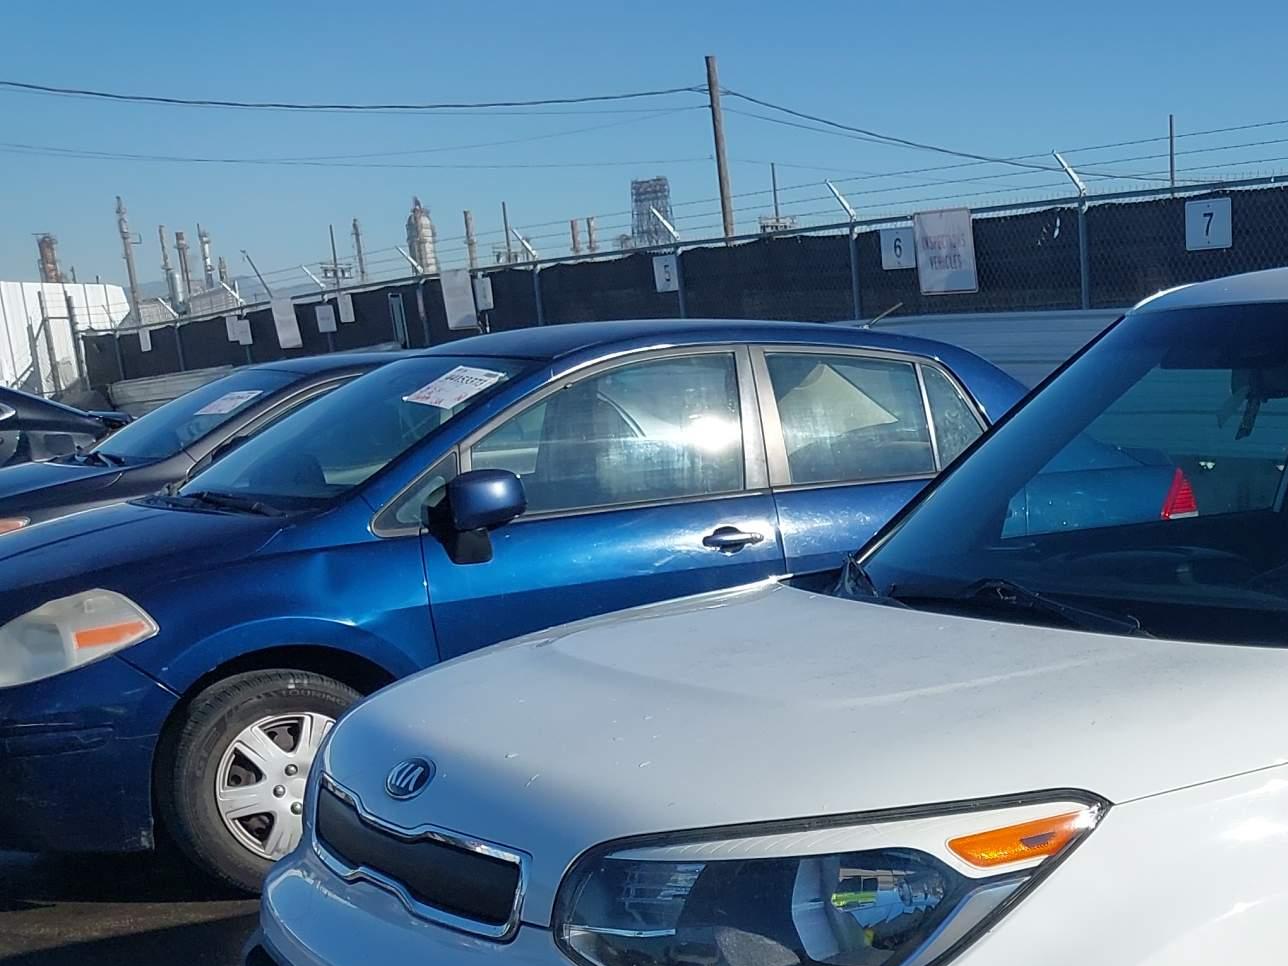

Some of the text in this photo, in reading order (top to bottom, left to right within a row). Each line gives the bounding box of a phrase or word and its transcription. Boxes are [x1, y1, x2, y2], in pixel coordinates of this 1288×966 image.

[1202, 212, 1215, 237] 7
[893, 238, 903, 259] 6
[663, 264, 672, 283] 5
